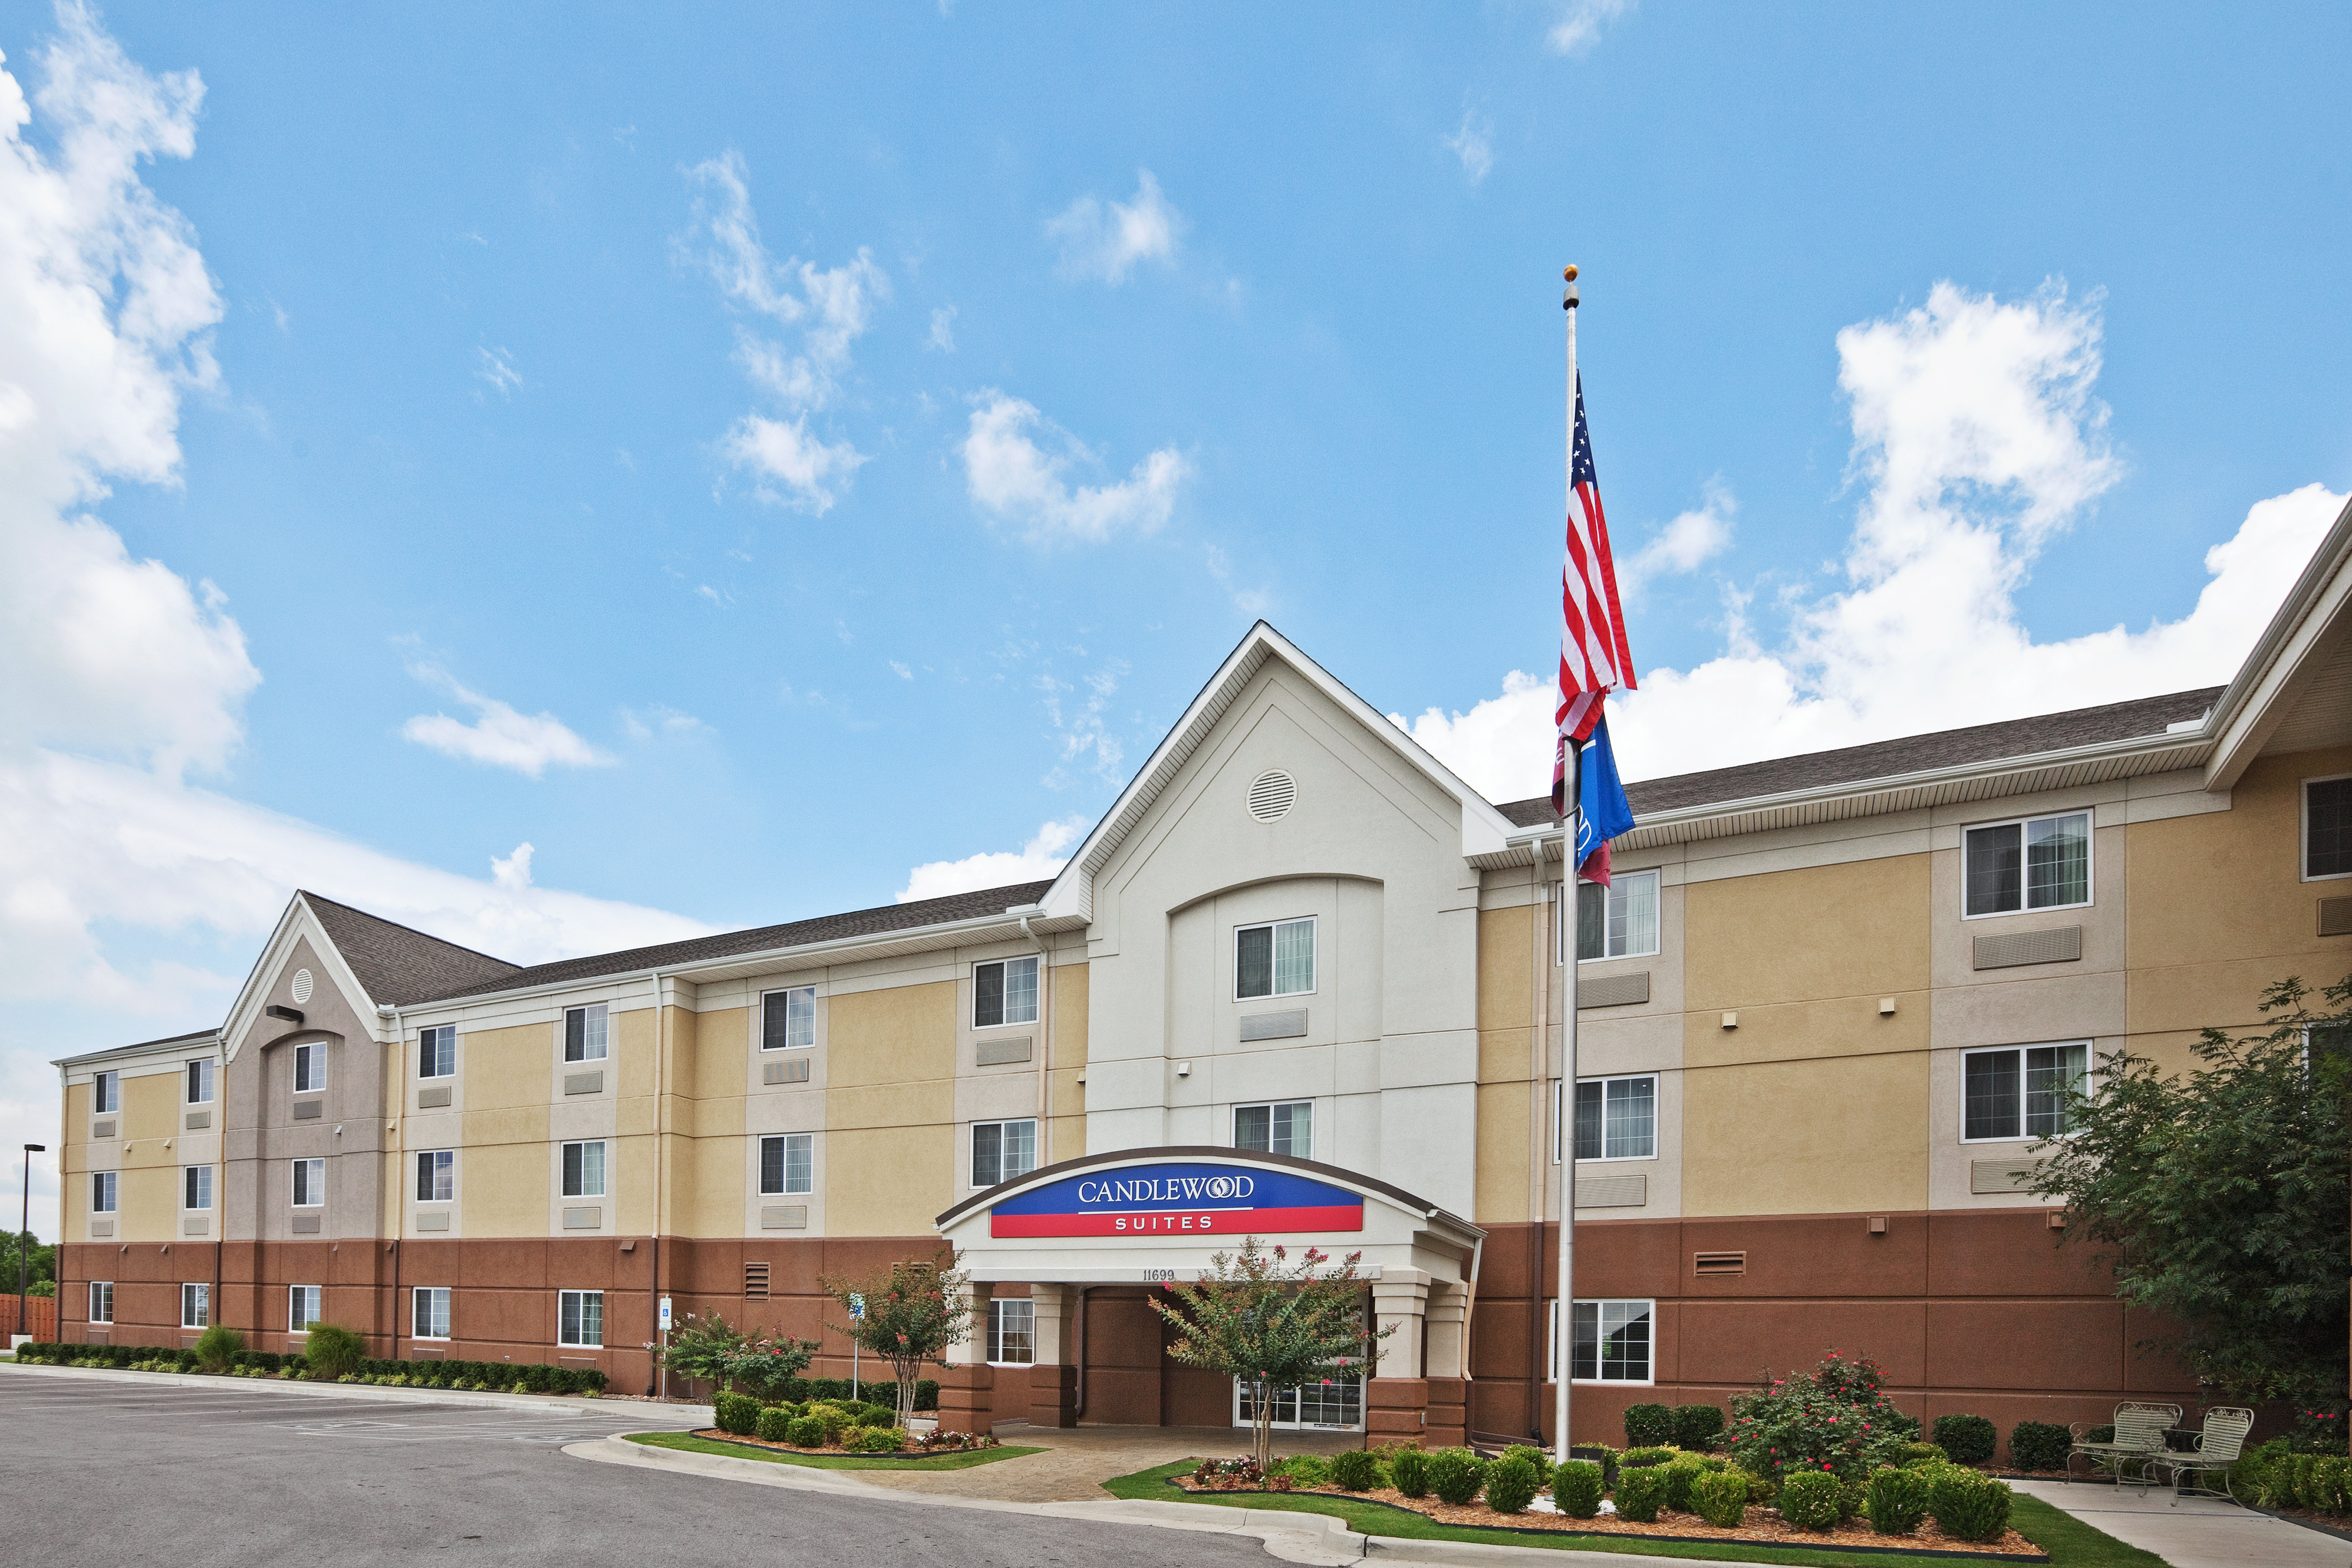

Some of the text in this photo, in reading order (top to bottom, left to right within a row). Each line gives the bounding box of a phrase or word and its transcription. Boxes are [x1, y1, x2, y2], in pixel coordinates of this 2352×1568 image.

[1078, 1176, 1254, 1202] CANDLEWOOD
[1116, 1216, 1212, 1230] SUITES
[1144, 1269, 1174, 1281] 11699
